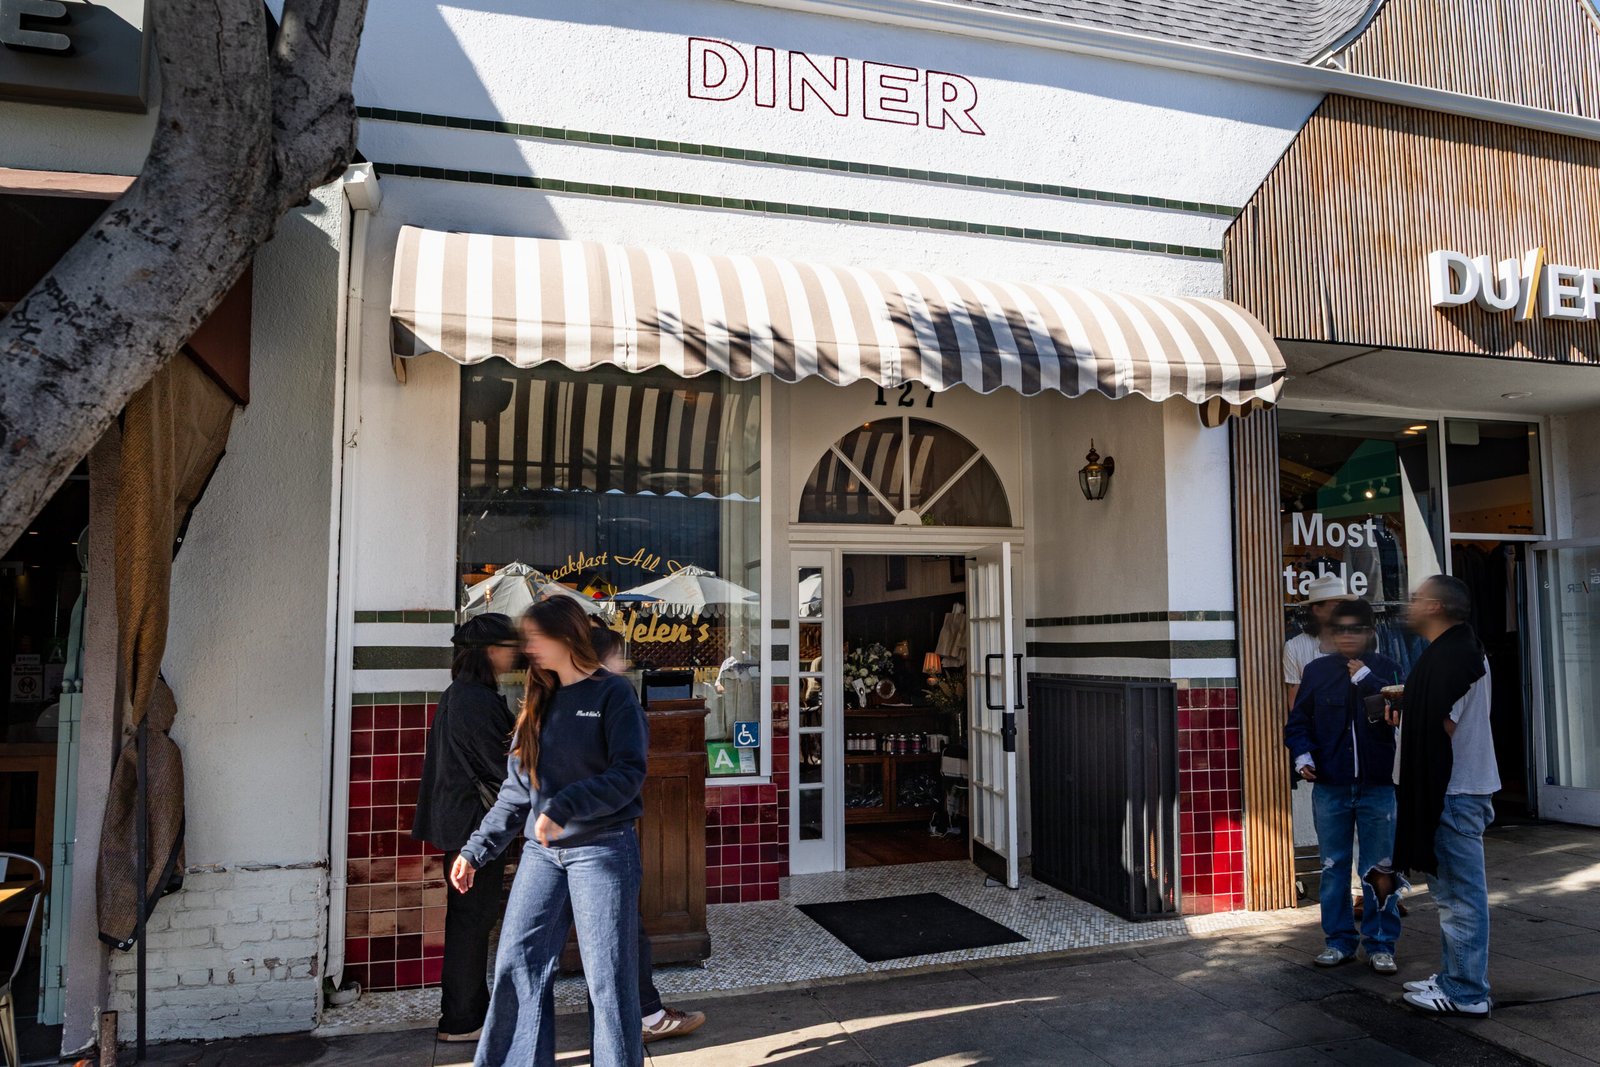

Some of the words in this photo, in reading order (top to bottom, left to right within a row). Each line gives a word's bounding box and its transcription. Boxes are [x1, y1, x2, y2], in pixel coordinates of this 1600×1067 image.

[688, 37, 986, 136] DINER
[874, 380, 936, 408] 127
[1292, 512, 1378, 548] Most
[525, 551, 609, 598] Breakfast
[612, 547, 662, 573] All
[608, 608, 710, 643] Helen's
[714, 748, 735, 768] A
